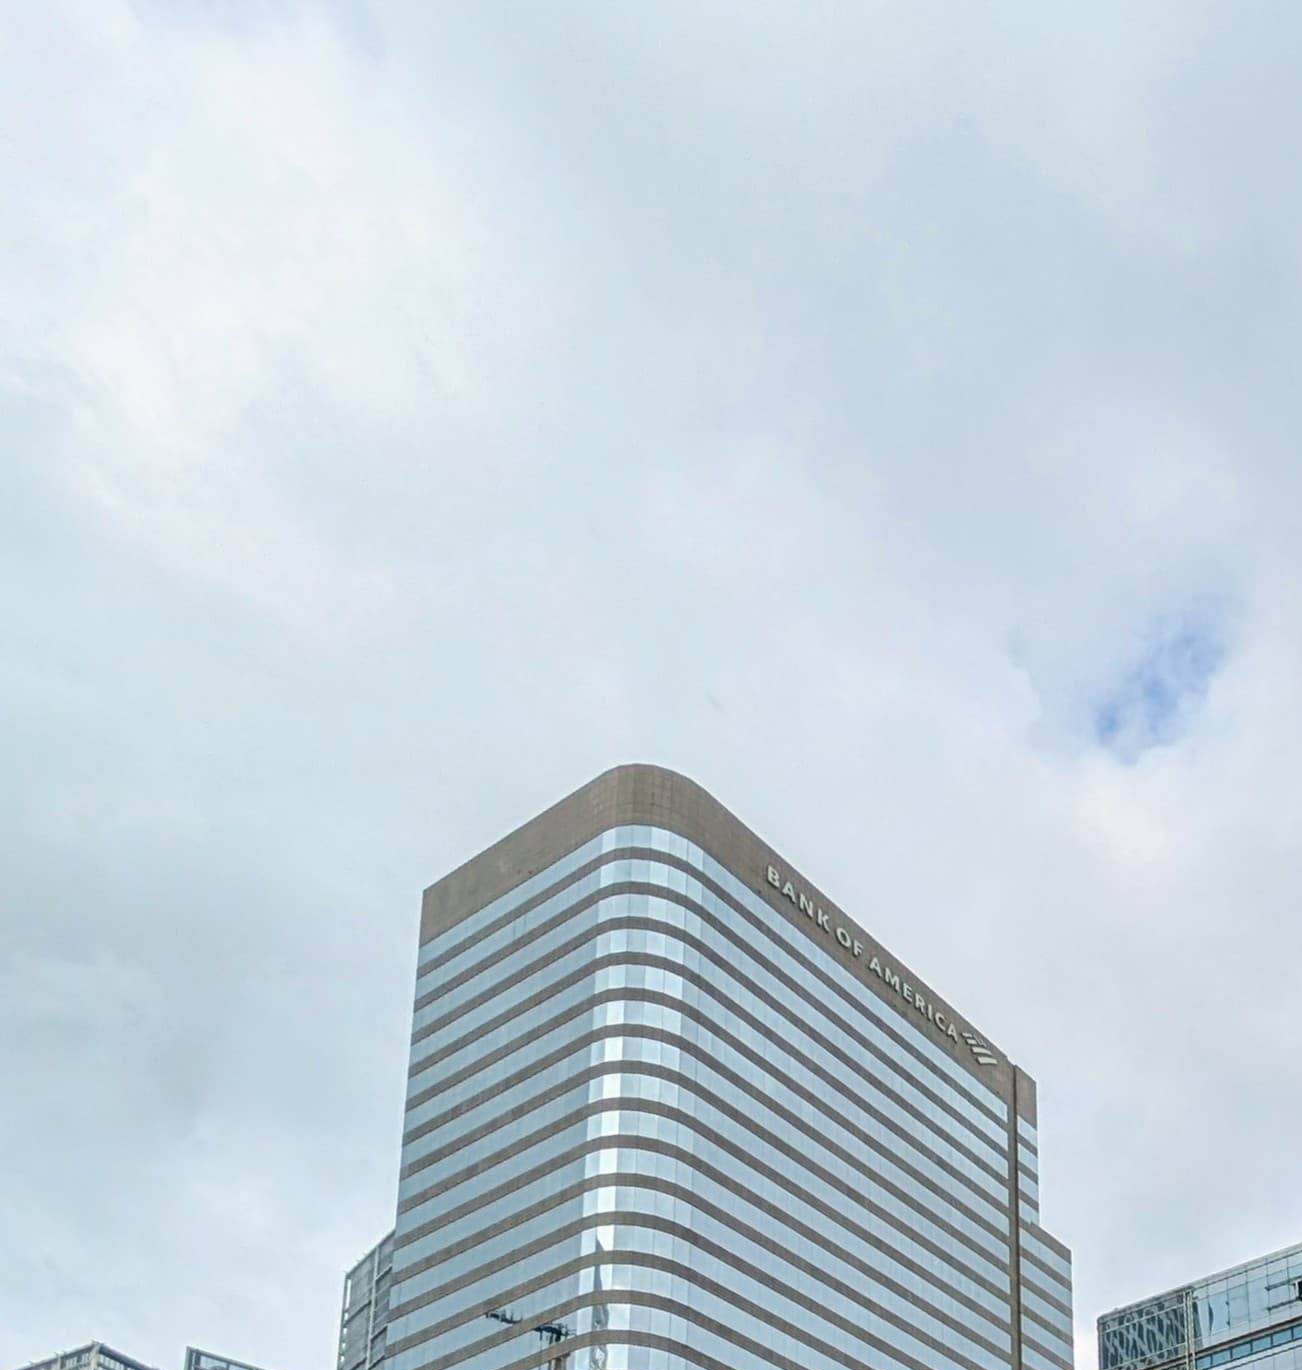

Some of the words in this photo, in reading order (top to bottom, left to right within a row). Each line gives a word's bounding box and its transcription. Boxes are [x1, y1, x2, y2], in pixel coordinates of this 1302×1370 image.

[766, 864, 831, 934] BANK
[836, 927, 864, 957] OF
[868, 957, 960, 1044] AMERICA
